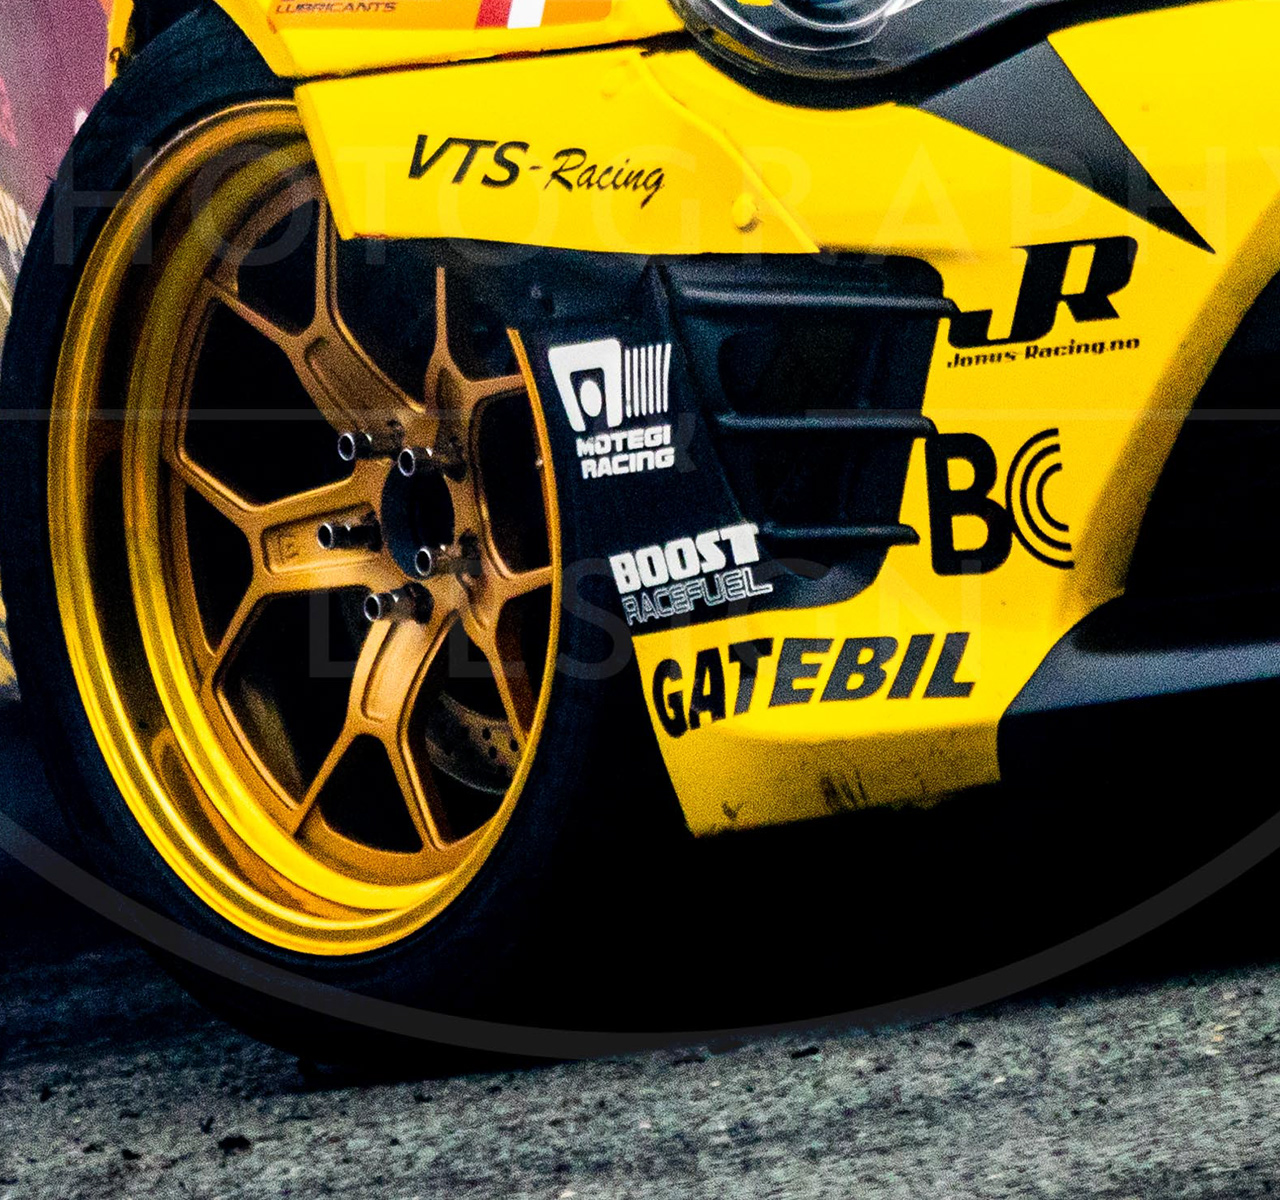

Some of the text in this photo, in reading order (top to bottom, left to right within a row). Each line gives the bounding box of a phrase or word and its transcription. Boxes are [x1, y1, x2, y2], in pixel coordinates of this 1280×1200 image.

[275, 0, 398, 16] LUBRICANTS
[575, 423, 672, 459] MOTEGI
[580, 445, 676, 481] RACING
[608, 521, 761, 594] BOOST
[621, 566, 774, 626] RACEFUEL
[650, 631, 977, 740] GATEBIL
